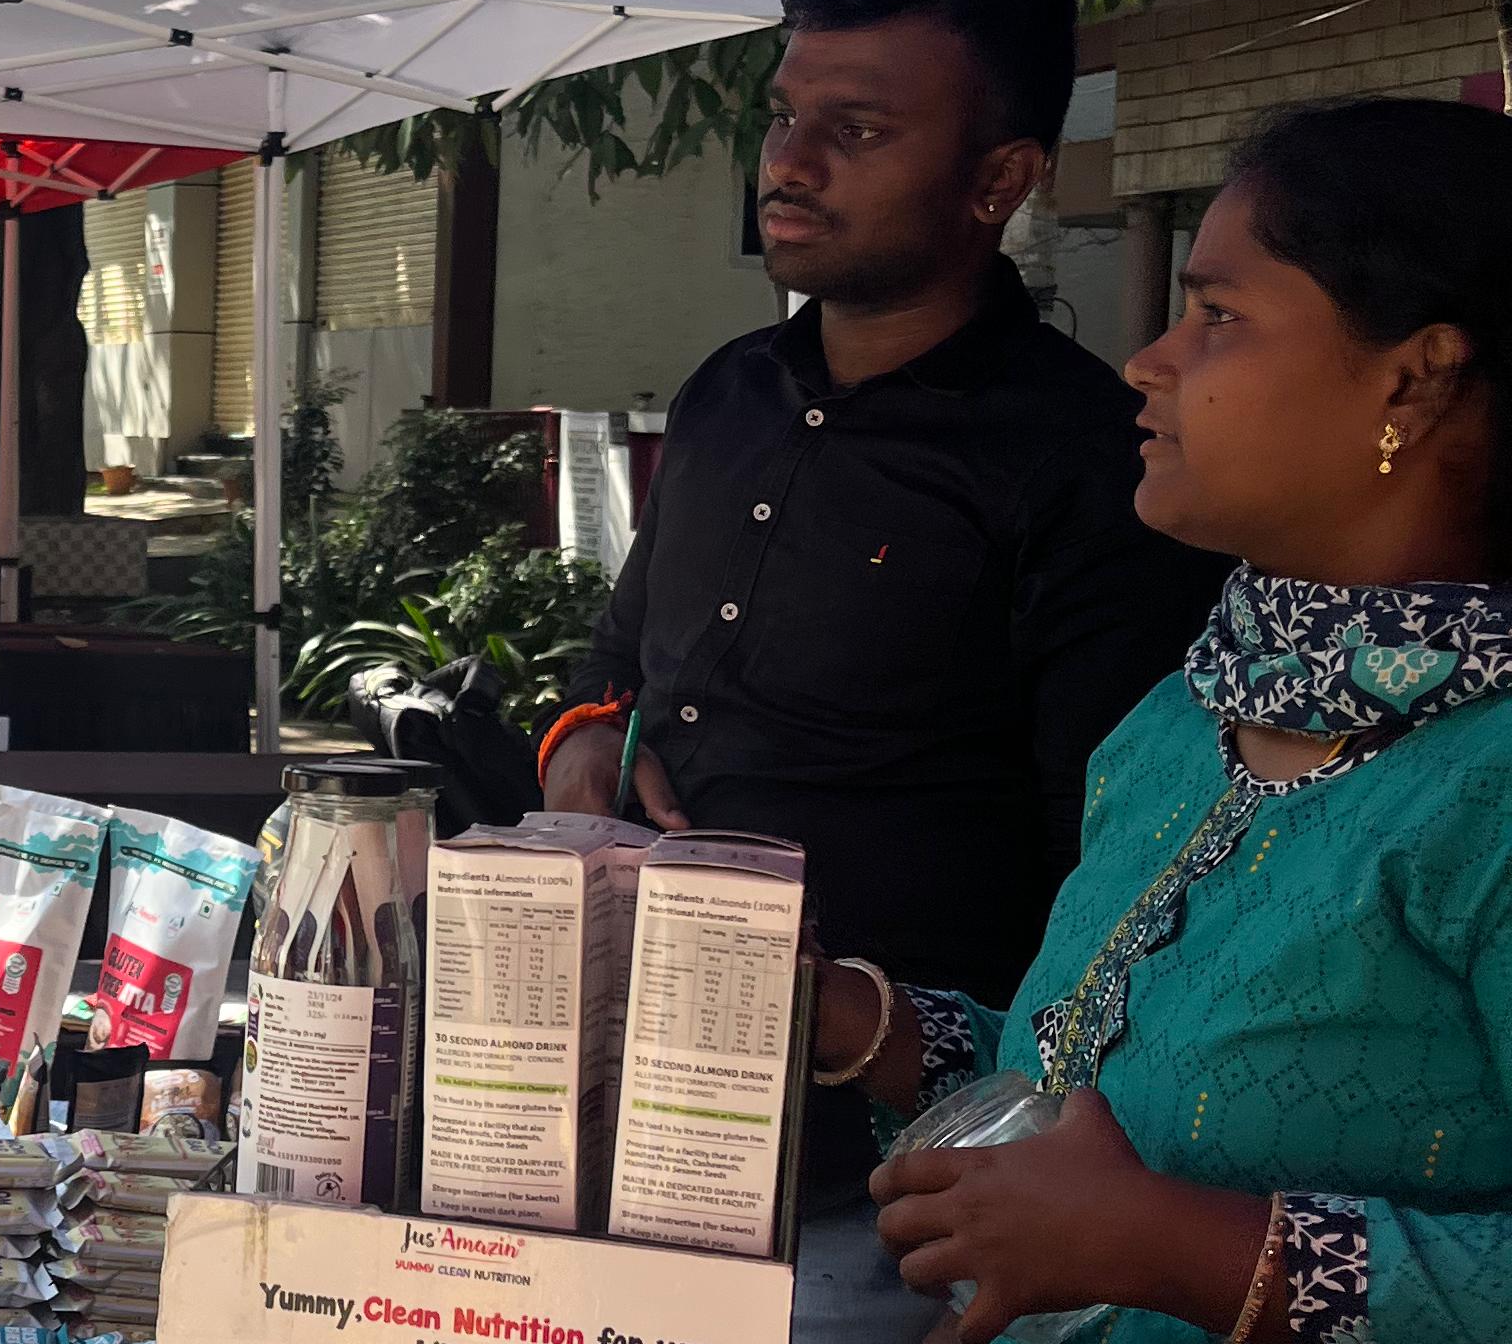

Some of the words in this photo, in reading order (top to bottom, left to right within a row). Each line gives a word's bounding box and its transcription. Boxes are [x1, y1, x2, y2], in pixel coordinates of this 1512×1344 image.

[435, 1033, 447, 1043] 30
[449, 1035, 488, 1047] SECOND
[490, 1038, 534, 1050] ALMOND
[536, 1041, 568, 1052] DRINK
[635, 1056, 649, 1066] 30
[650, 1059, 692, 1072] SECOND
[693, 1065, 738, 1077] ALMOND
[741, 1070, 774, 1082] DRINK
[395, 1260, 434, 1273] YUMMY
[438, 1266, 470, 1278] CLEAN
[474, 1270, 531, 1286] NUTRITION
